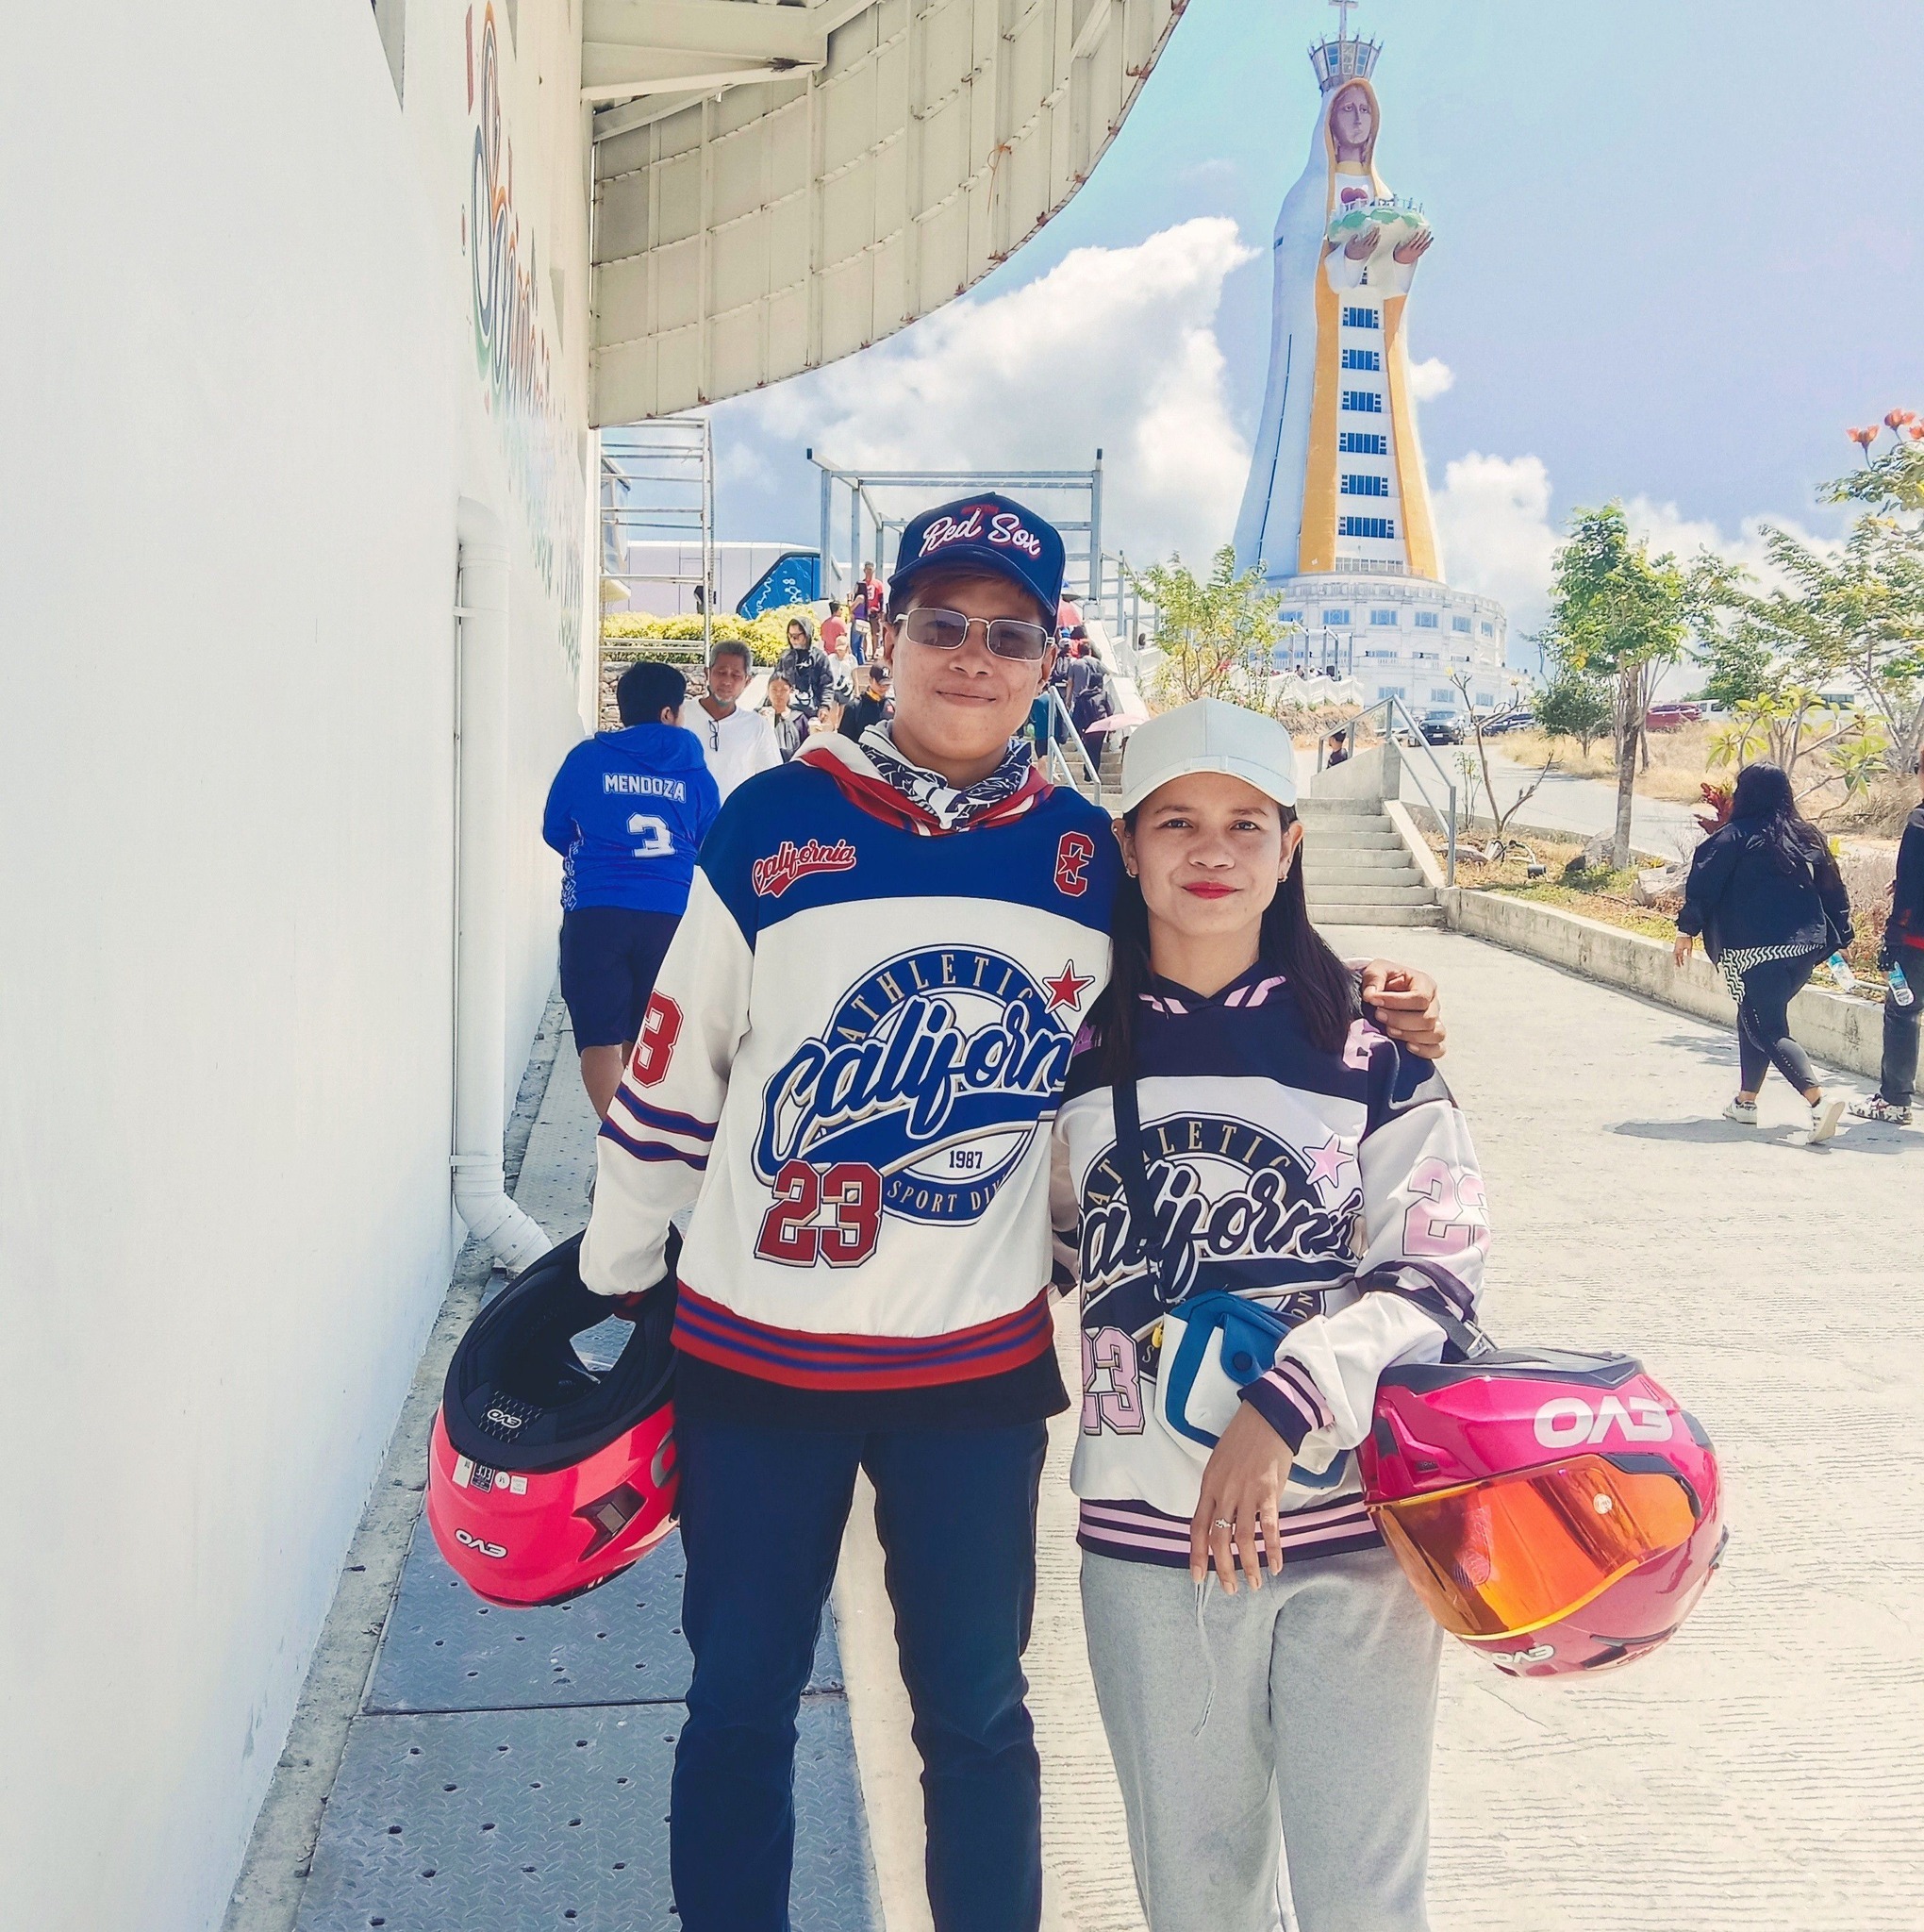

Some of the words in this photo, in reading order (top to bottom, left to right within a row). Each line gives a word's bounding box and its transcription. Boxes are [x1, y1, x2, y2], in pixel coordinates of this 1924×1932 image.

[918, 508, 982, 558] Red
[987, 512, 1041, 557] Sox
[603, 773, 687, 804] MENDOZA
[626, 812, 677, 858] 3
[752, 839, 856, 897] California
[1053, 830, 1095, 897] C
[949, 1150, 982, 1170] 1987
[755, 1158, 883, 1268] 23
[887, 1180, 957, 1213] SPORT
[487, 1408, 522, 1429] EVO
[1533, 1394, 1674, 1449] EVO
[455, 1528, 508, 1558] EVO
